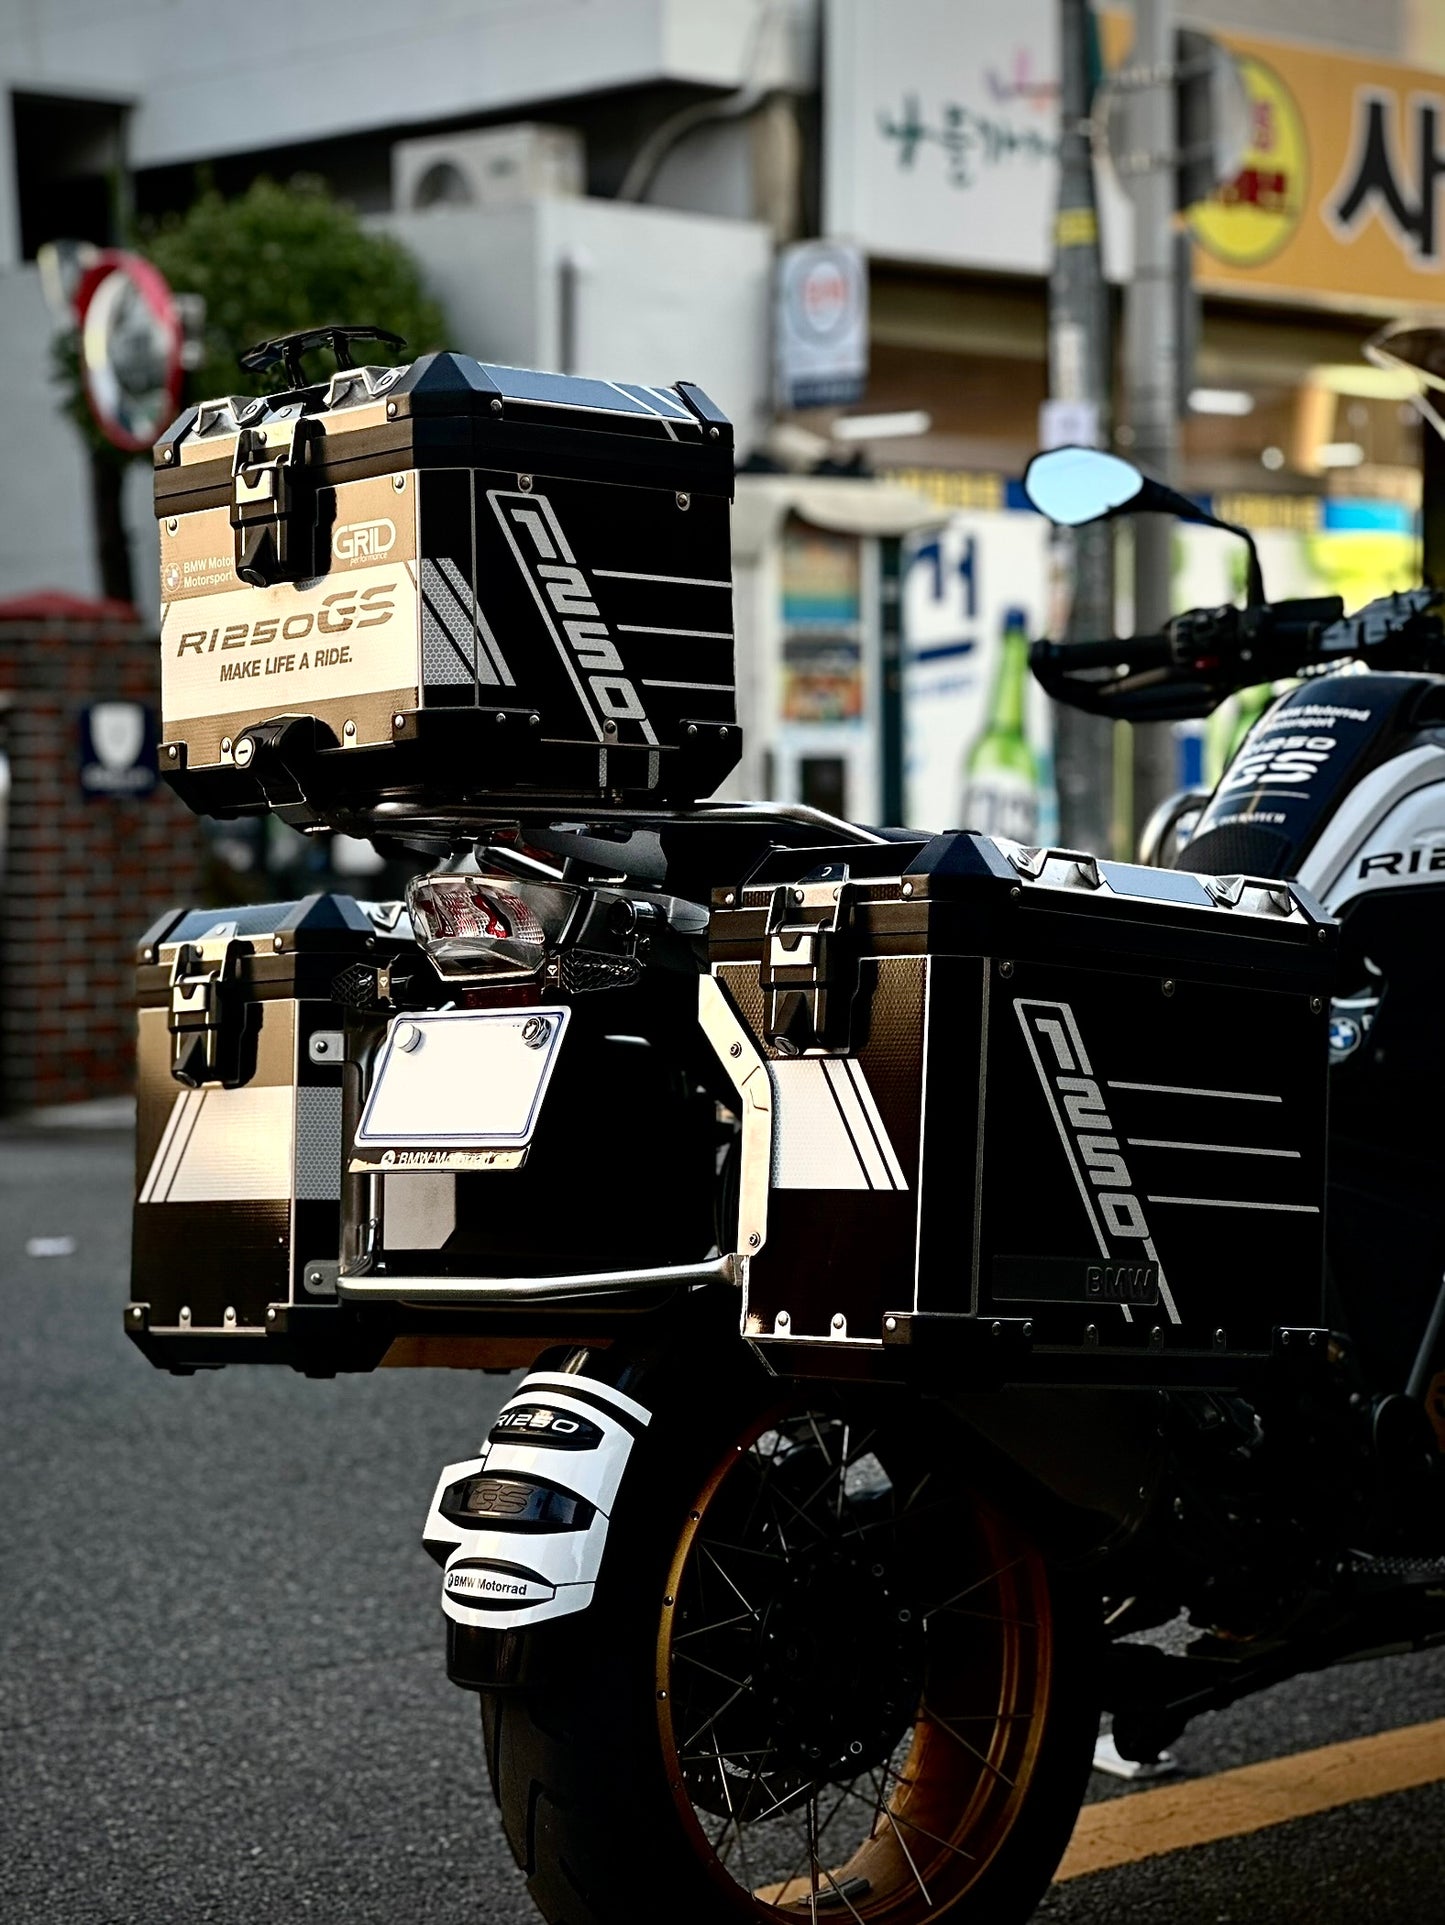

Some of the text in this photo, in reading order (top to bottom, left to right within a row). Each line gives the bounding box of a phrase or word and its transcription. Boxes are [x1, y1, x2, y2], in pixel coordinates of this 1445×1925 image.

[332, 517, 397, 560] GRID
[183, 559, 207, 573] BMW
[183, 570, 233, 588] Motorsport
[510, 508, 647, 719] 1250
[219, 645, 353, 682] MAKE LIFE A RIDE.
[1303, 704, 1371, 722] Motorrad
[1035, 1018, 1150, 1238] 1250
[400, 1151, 434, 1164] BMW
[1086, 1266, 1152, 1298] BMW
[467, 1481, 534, 1514] GS
[454, 1576, 527, 1596] BMW Motorrad
